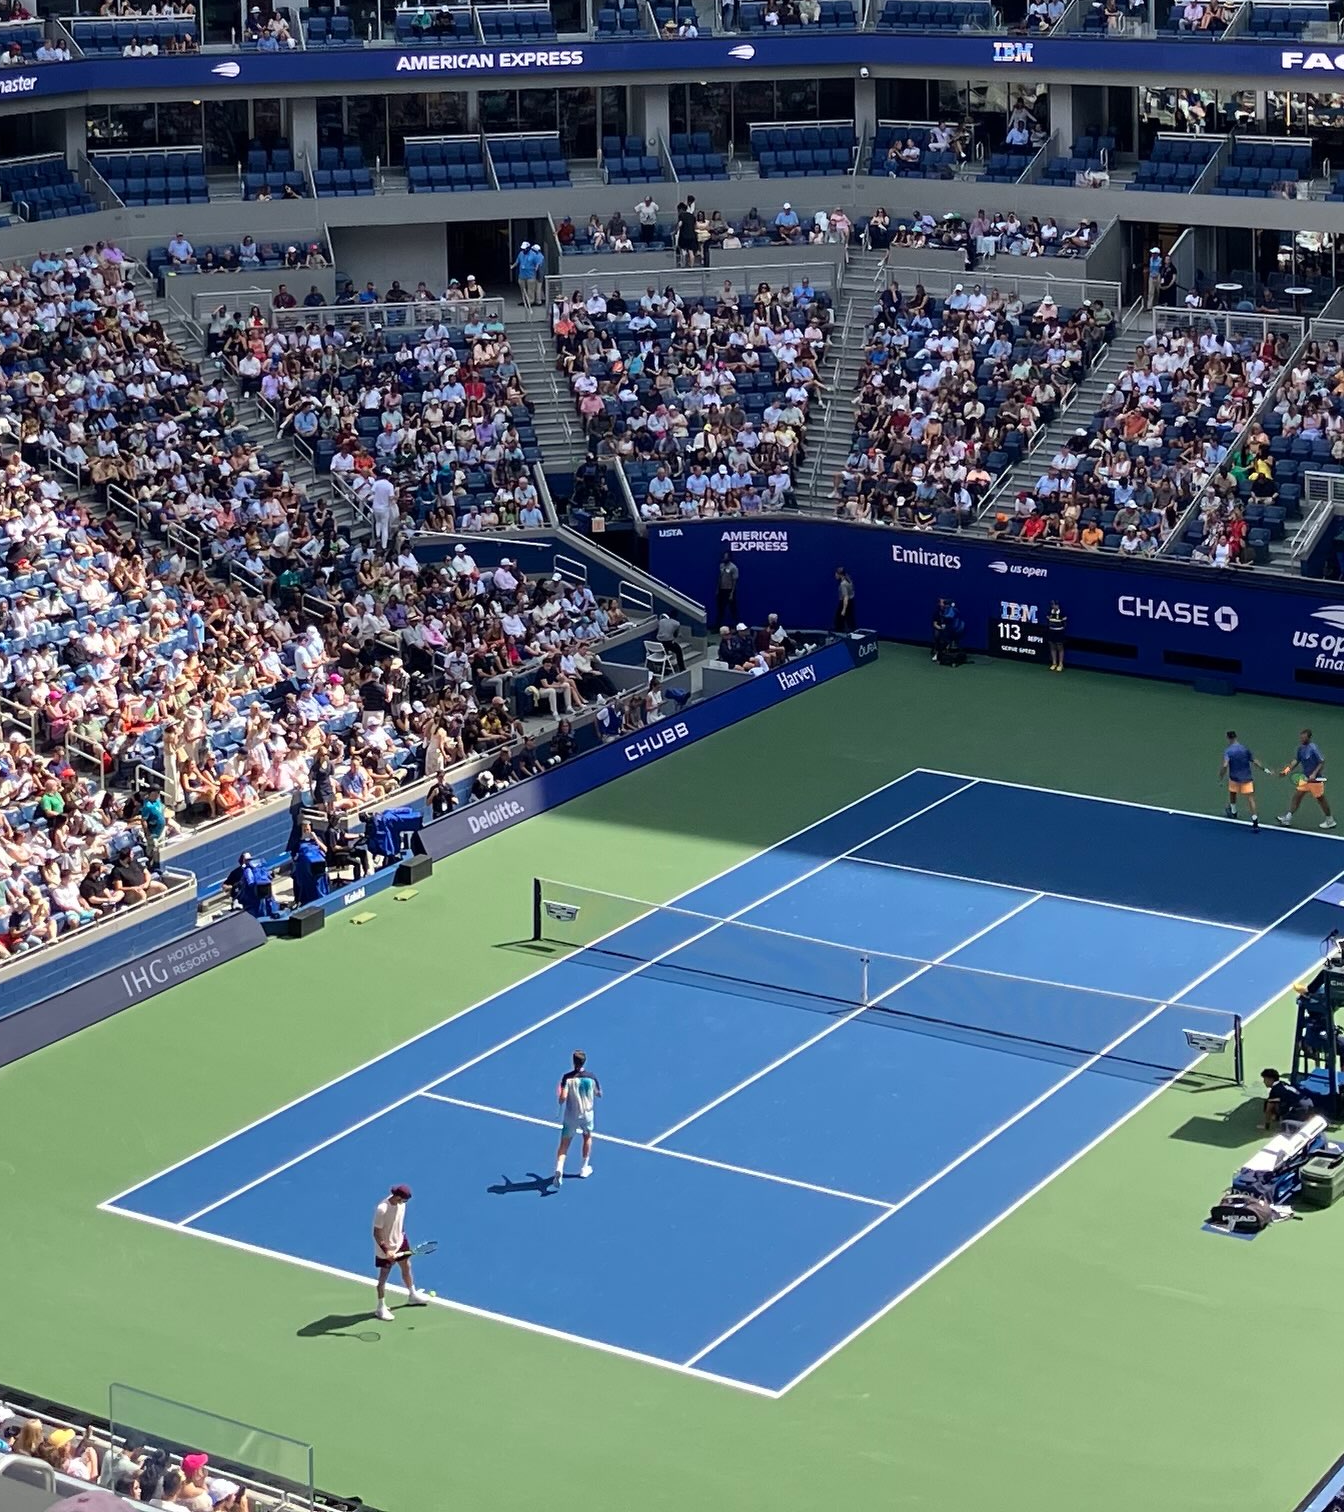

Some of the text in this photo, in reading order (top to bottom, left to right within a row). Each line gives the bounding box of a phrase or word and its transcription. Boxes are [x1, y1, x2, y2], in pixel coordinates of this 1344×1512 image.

[396, 51, 583, 71] AMERICAN EXPRESS
[992, 42, 1034, 63] IBM
[721, 531, 788, 542] AMERICAN
[730, 541, 788, 552] EXPRESS
[892, 545, 961, 570] Emirates
[1010, 565, 1048, 578] us open
[1001, 601, 1038, 624] IBM
[1118, 595, 1209, 627] CHASE
[997, 622, 1021, 641] 113
[1292, 631, 1318, 651] us
[776, 664, 817, 691] Harvey
[624, 722, 689, 762] CHUBB
[467, 799, 525, 835] Deloitte.
[167, 938, 207, 963] HOTELS
[173, 946, 220, 976] RESORTS
[121, 960, 169, 997] IHG
